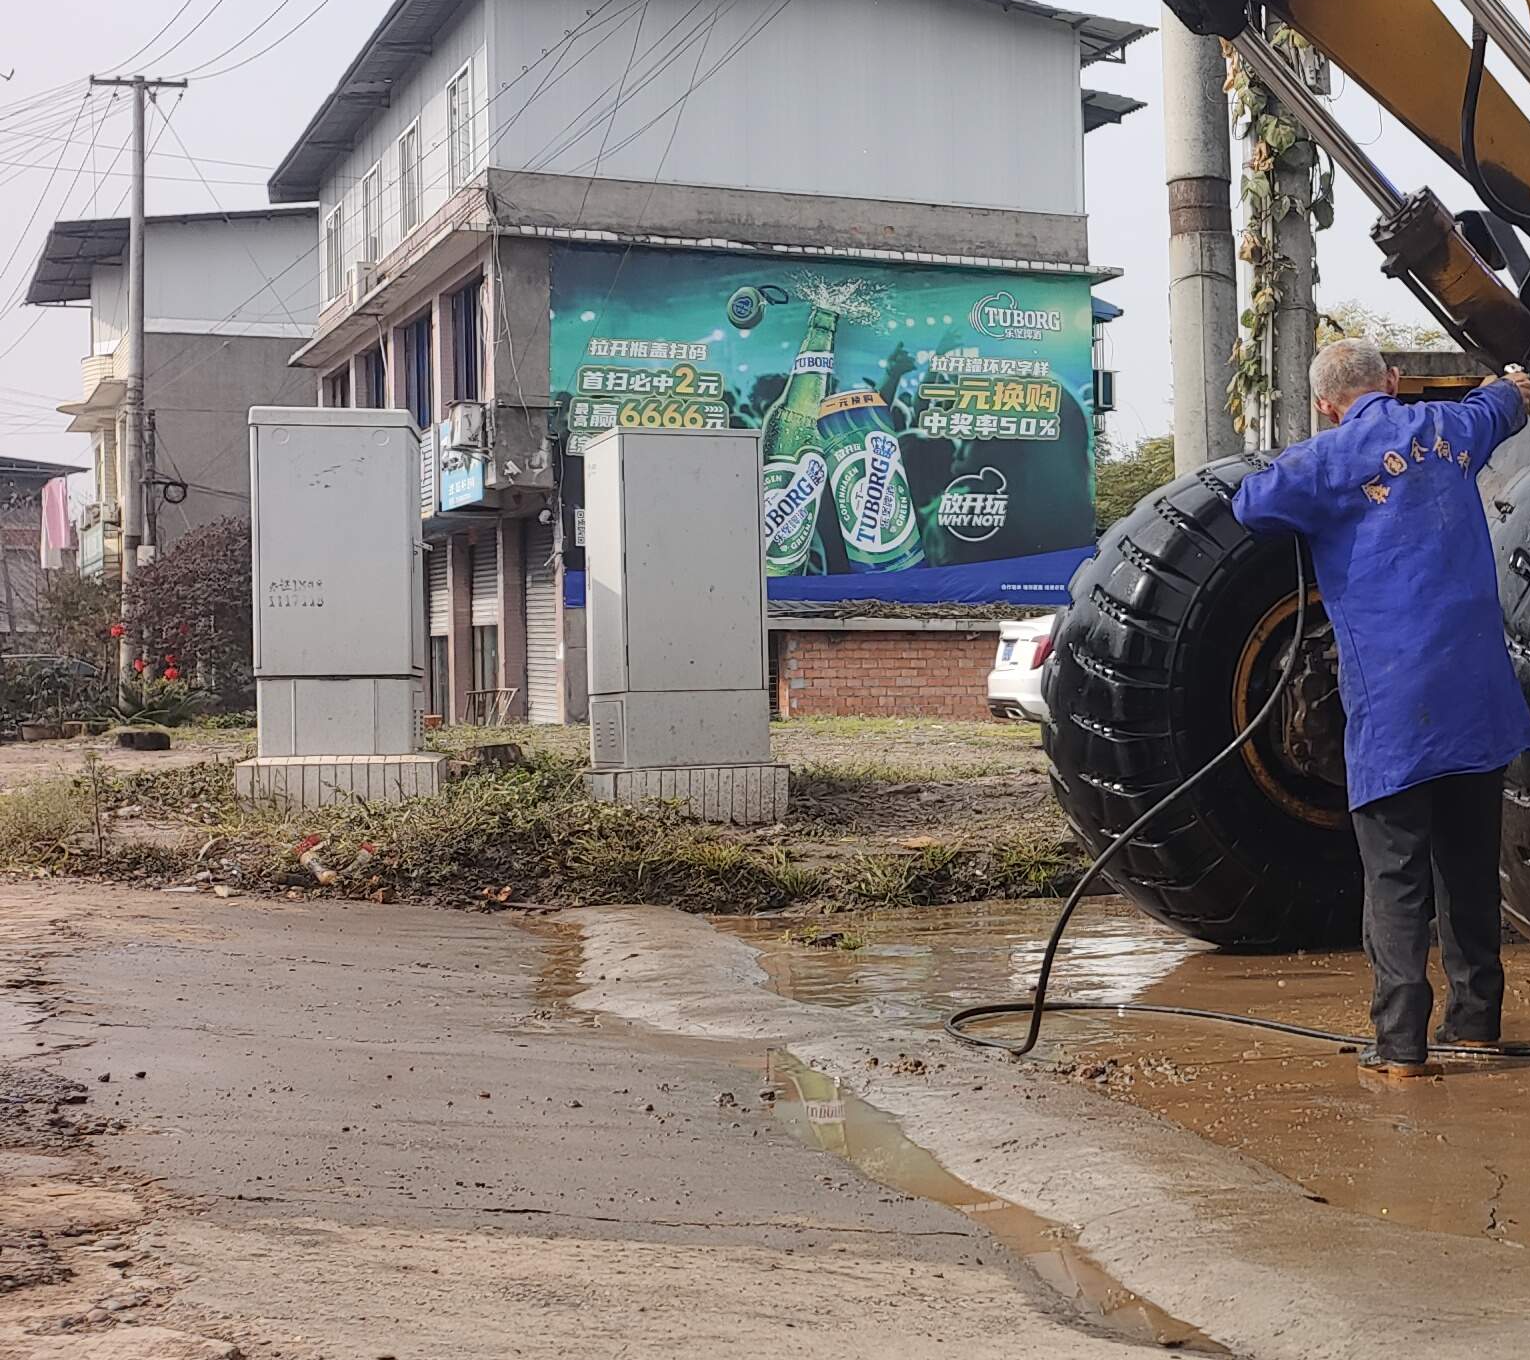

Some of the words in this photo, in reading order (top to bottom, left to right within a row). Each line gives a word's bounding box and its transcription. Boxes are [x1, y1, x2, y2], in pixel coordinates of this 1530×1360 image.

[984, 307, 1062, 332] TUBORG
[589, 340, 709, 361] 拉开瓶盖扫码
[930, 356, 1049, 377] 拉开罐环见字样
[582, 367, 719, 395] 首扫必中2元
[923, 380, 1057, 413] 一元换购
[923, 413, 1057, 437] 中奖率50%
[839, 466, 860, 521] COPENHAGEN
[856, 456, 891, 544] TUBORG
[938, 492, 1009, 515] 放开玩
[895, 496, 908, 527] GREEN
[938, 514, 973, 527] WHY
